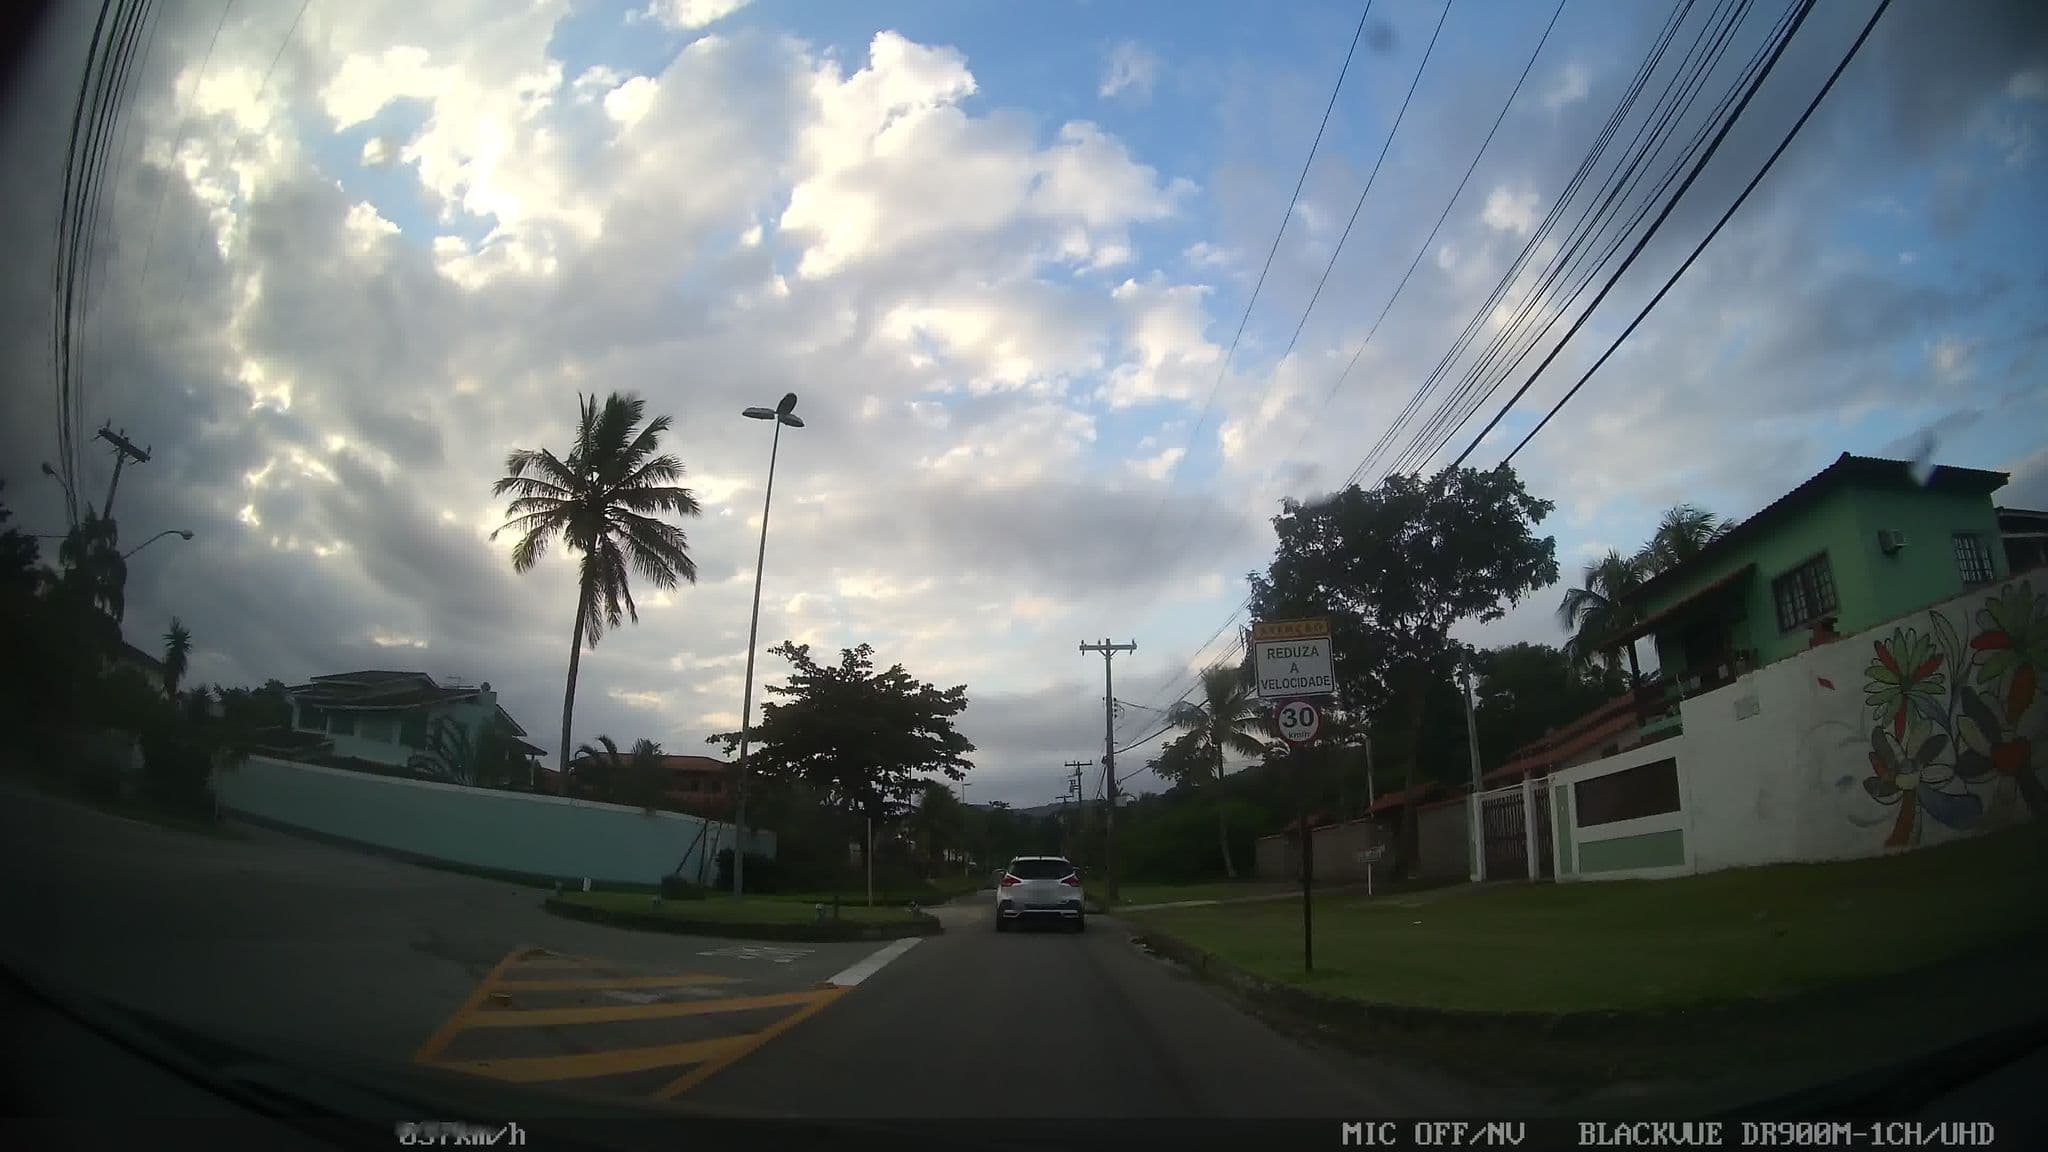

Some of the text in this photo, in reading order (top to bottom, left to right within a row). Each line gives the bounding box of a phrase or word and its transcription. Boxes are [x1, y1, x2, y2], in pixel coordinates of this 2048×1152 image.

[1266, 646, 1320, 660] REDUZA
[1289, 662, 1300, 674] A
[1260, 675, 1331, 690] VELOCIDADE
[1281, 706, 1315, 728] 30
